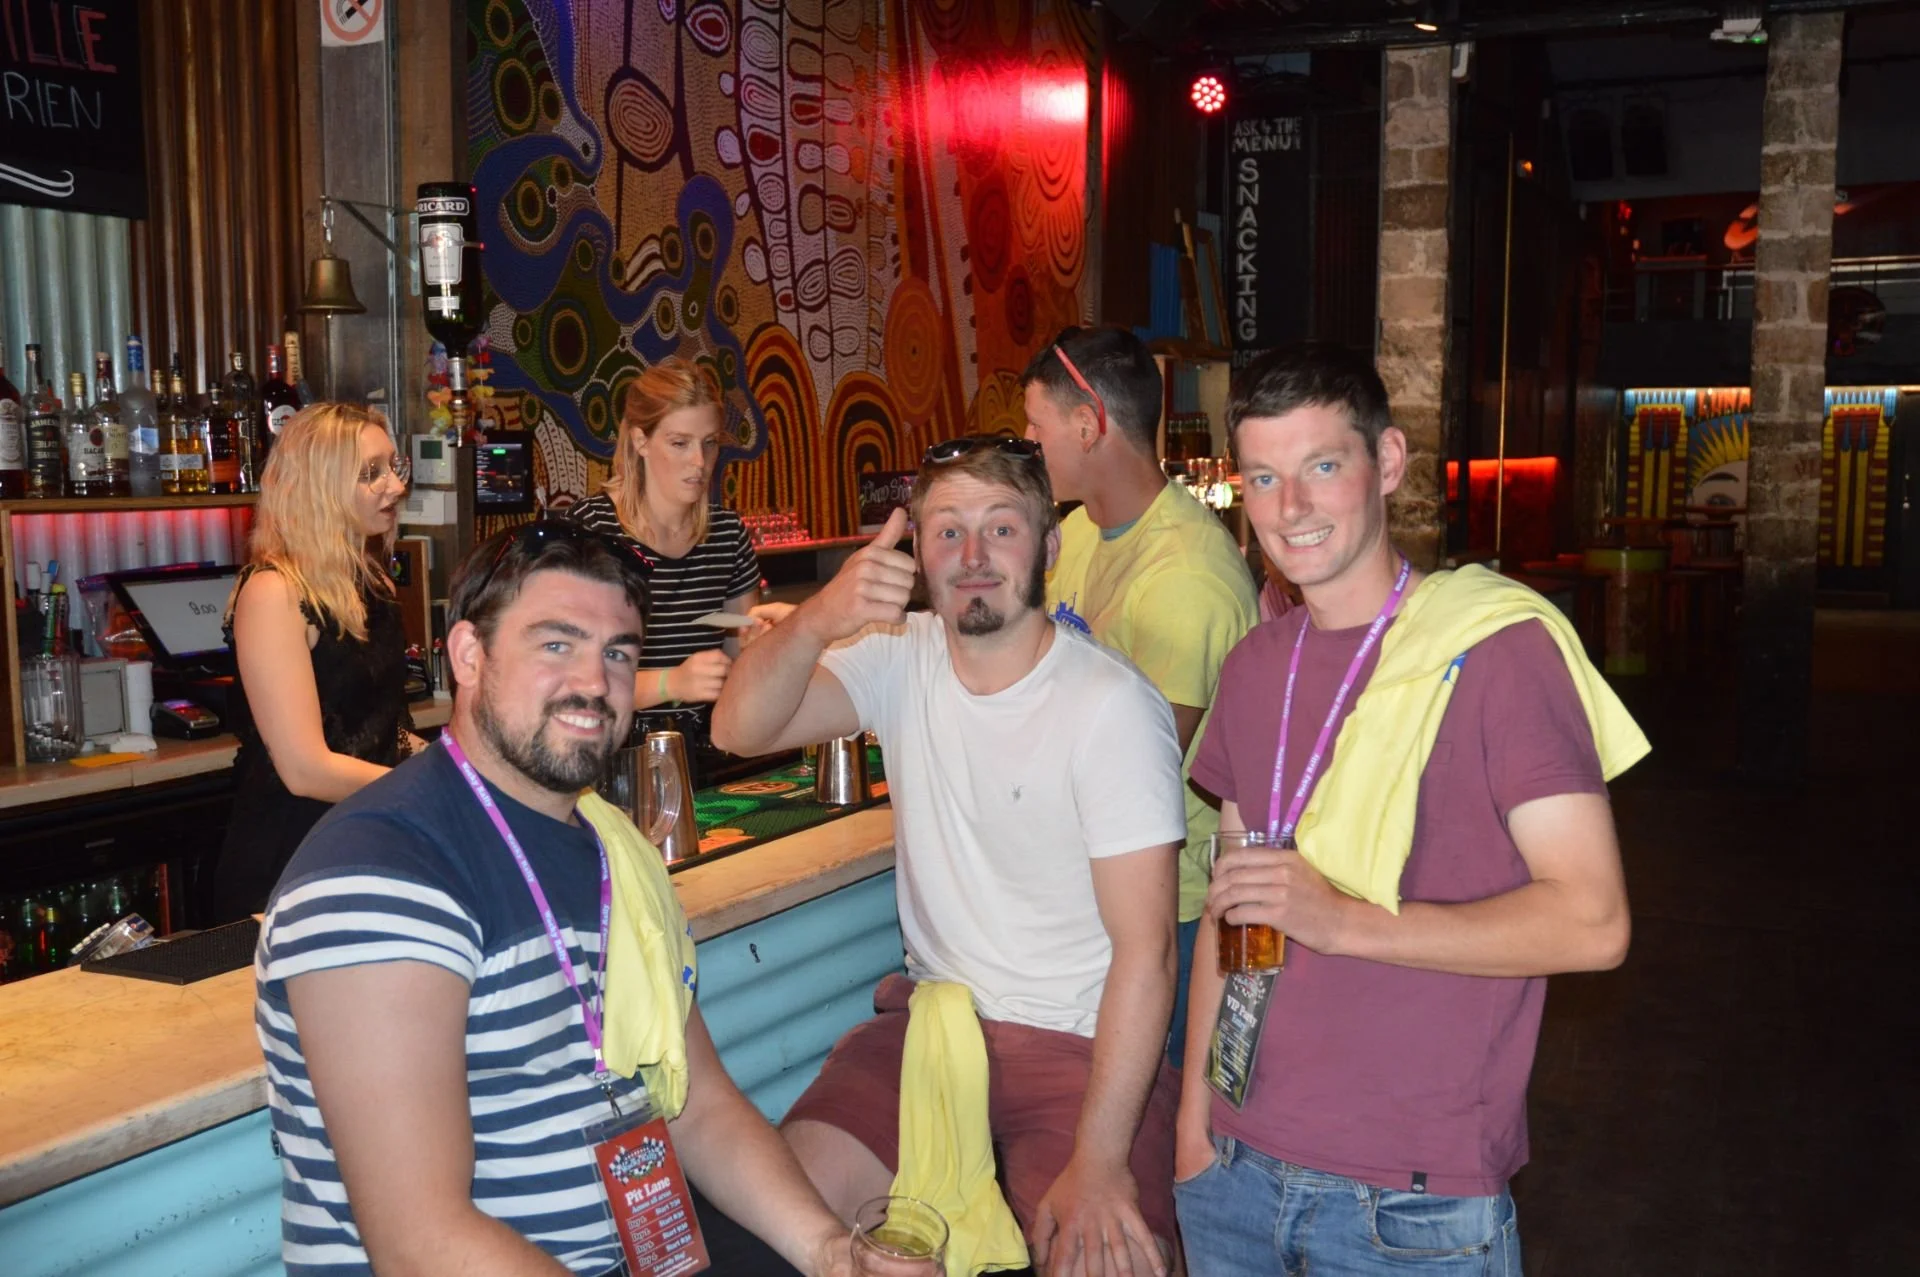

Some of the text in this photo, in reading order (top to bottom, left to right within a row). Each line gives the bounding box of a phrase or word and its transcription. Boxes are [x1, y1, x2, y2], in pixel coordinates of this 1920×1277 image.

[3, 71, 101, 129] RIEN
[1233, 118, 1260, 137] ASK
[1273, 116, 1302, 134] THE
[417, 200, 466, 213] RICARD
[1236, 157, 1260, 341] SNACKING
[1356, 615, 1387, 657] Wacky Rally
[1323, 683, 1350, 728] Wacky Rally
[461, 761, 493, 808] Wacky Rally
[1296, 753, 1321, 798] Wacky Rally
[507, 833, 535, 883] Wacky Rally
[544, 910, 567, 962] Wacky Rally
[1226, 994, 1240, 1013] VIP
[625, 1176, 671, 1207] Pit Lane
